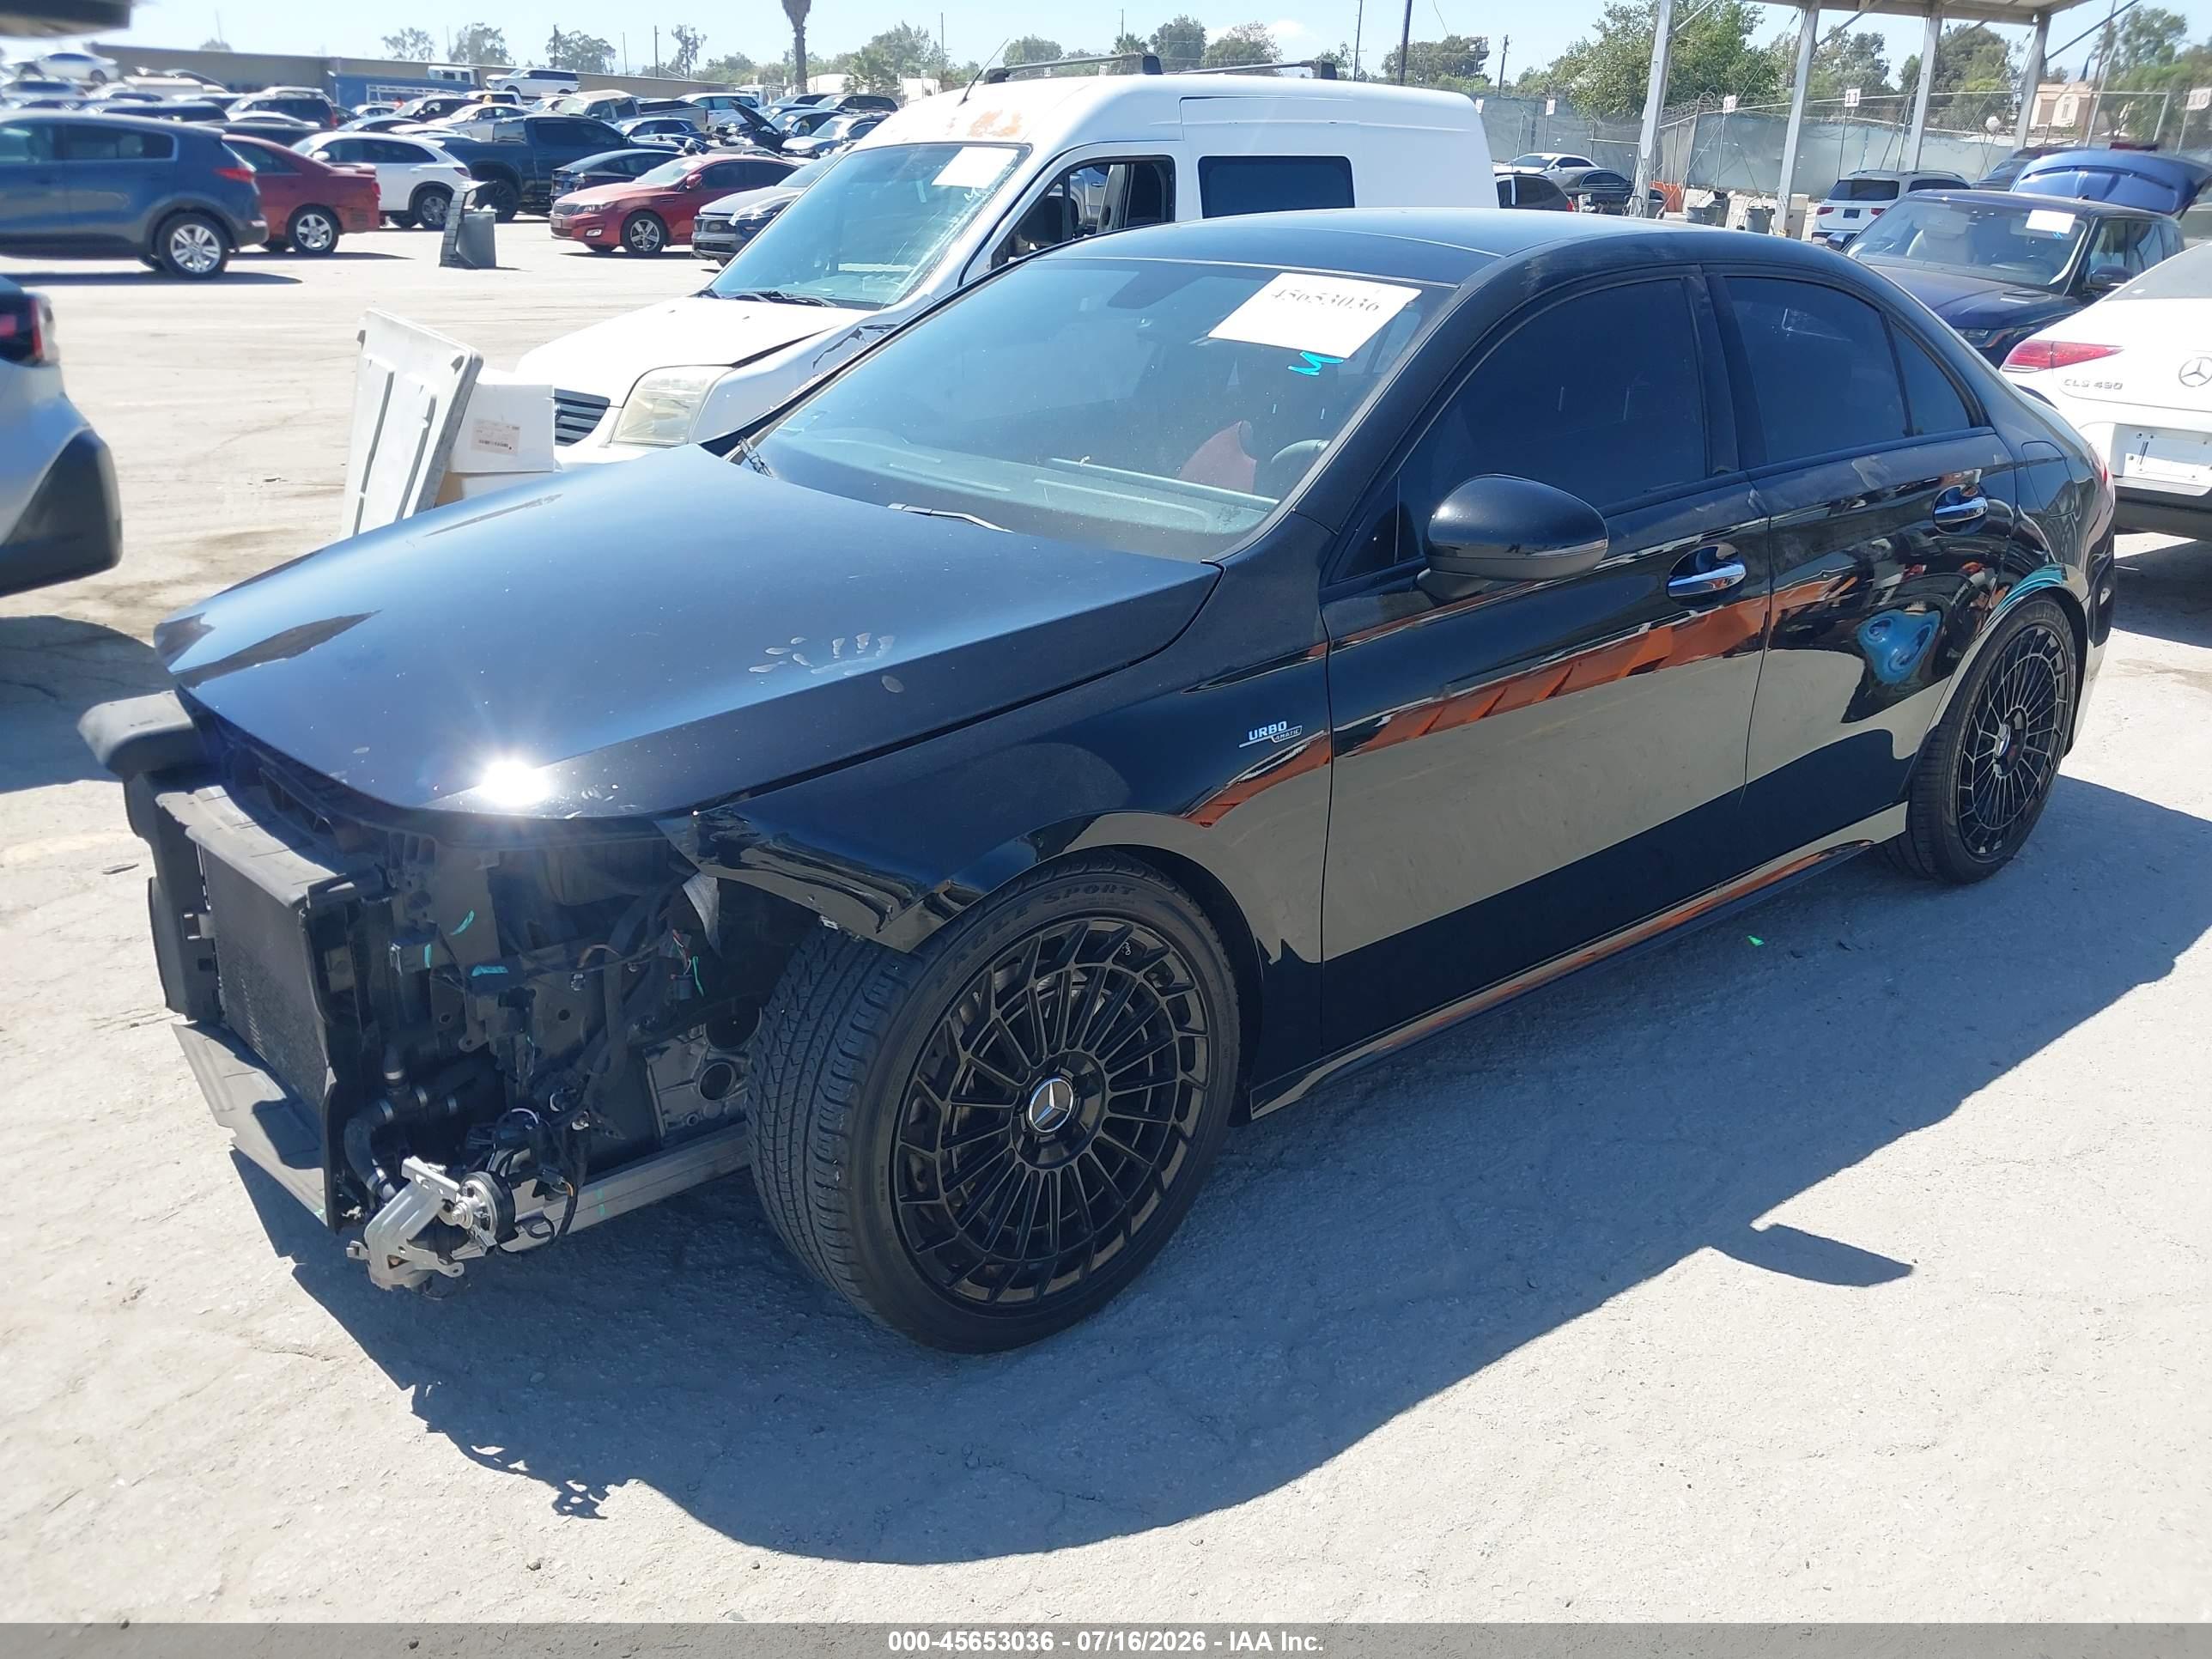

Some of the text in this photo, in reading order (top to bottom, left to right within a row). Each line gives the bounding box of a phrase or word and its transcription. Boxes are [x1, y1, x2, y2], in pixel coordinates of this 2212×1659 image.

[1846, 93, 1859, 104] 11
[1725, 99, 1735, 110] 12
[2063, 379, 2090, 388] CLS
[1248, 720, 1288, 741] URBO
[1042, 882, 1137, 904] SPORT
